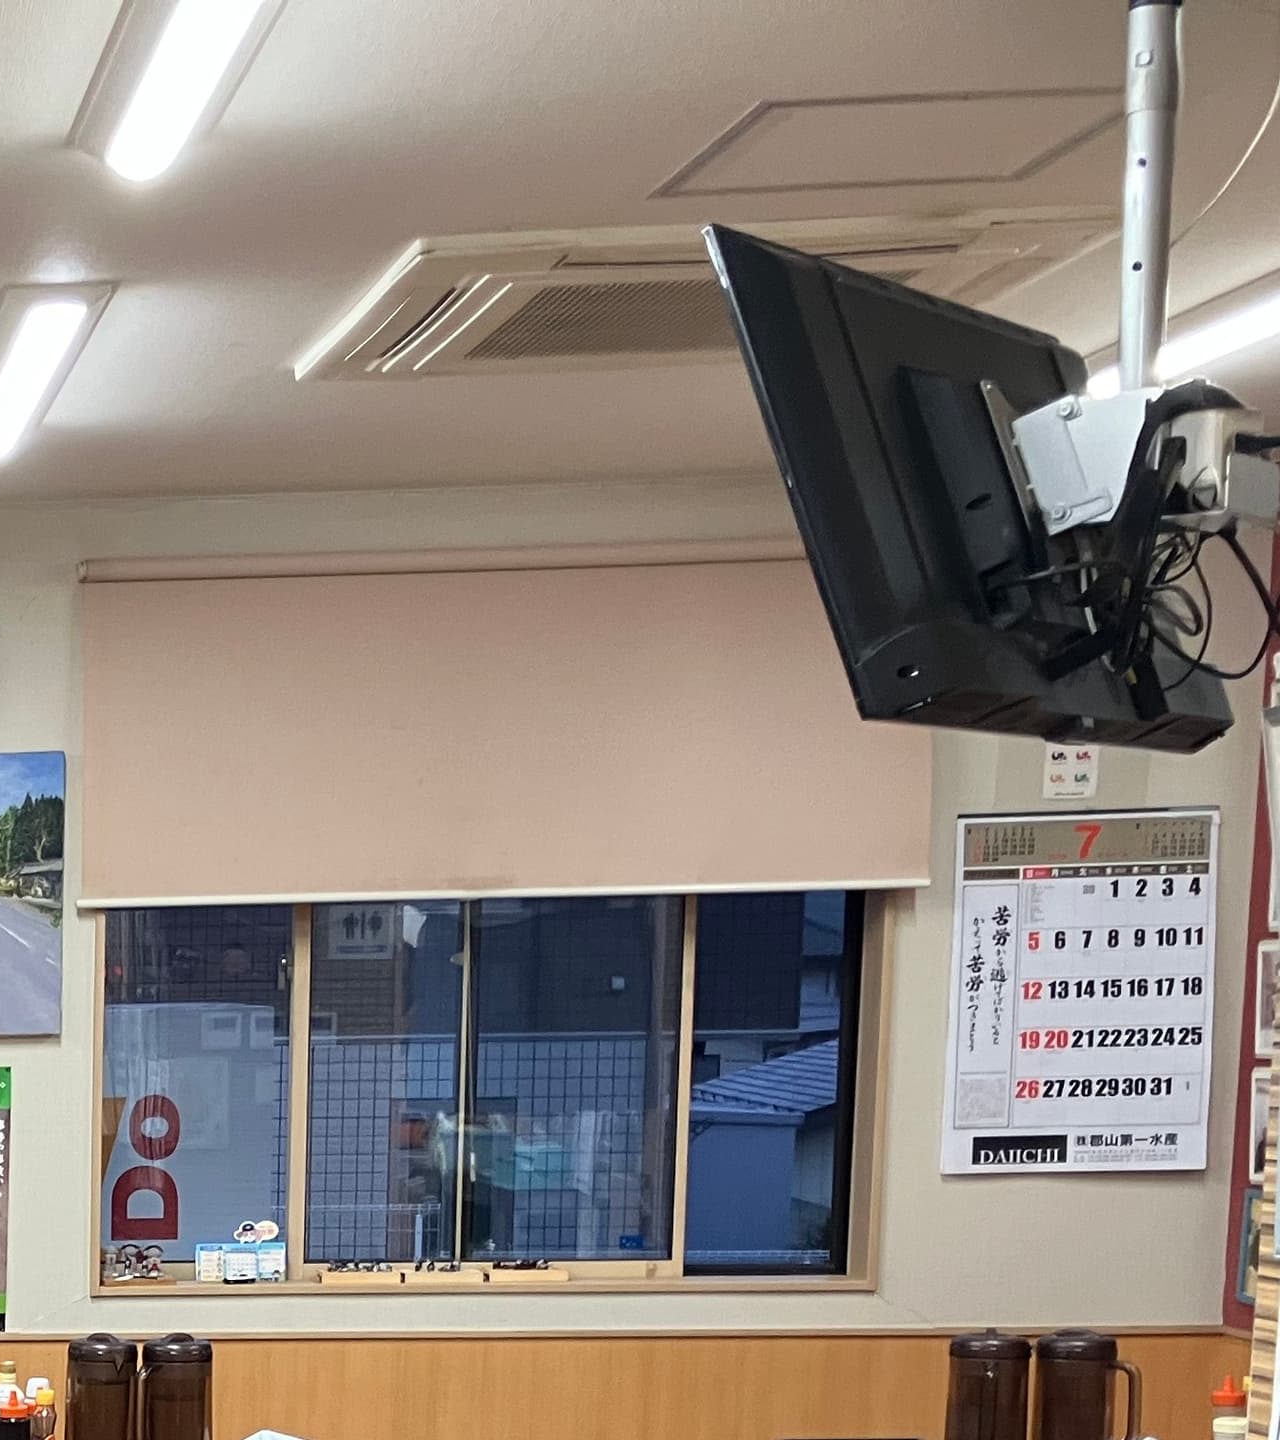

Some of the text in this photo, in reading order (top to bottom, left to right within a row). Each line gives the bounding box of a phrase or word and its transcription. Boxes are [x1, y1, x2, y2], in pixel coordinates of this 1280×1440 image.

[1074, 823, 1101, 860] 7
[1111, 880, 1118, 897] 1
[1136, 879, 1147, 897] 2
[1162, 878, 1173, 896] 3
[1189, 877, 1201, 895] 4
[1029, 927, 1203, 950] 5 6 7 8 9 10 11
[1023, 977, 1202, 999] 12 13 14 15 16 17 18
[1021, 1027, 1202, 1048] 19 20 21 22 23 24 25
[1016, 1081, 1039, 1098] 26
[1043, 1080, 1065, 1098] 27
[1068, 1079, 1092, 1097] 28
[1095, 1079, 1119, 1096] 29
[1122, 1078, 1146, 1096] 30
[1150, 1077, 1172, 1095] 31
[979, 1149, 1060, 1164] DAIICHI
